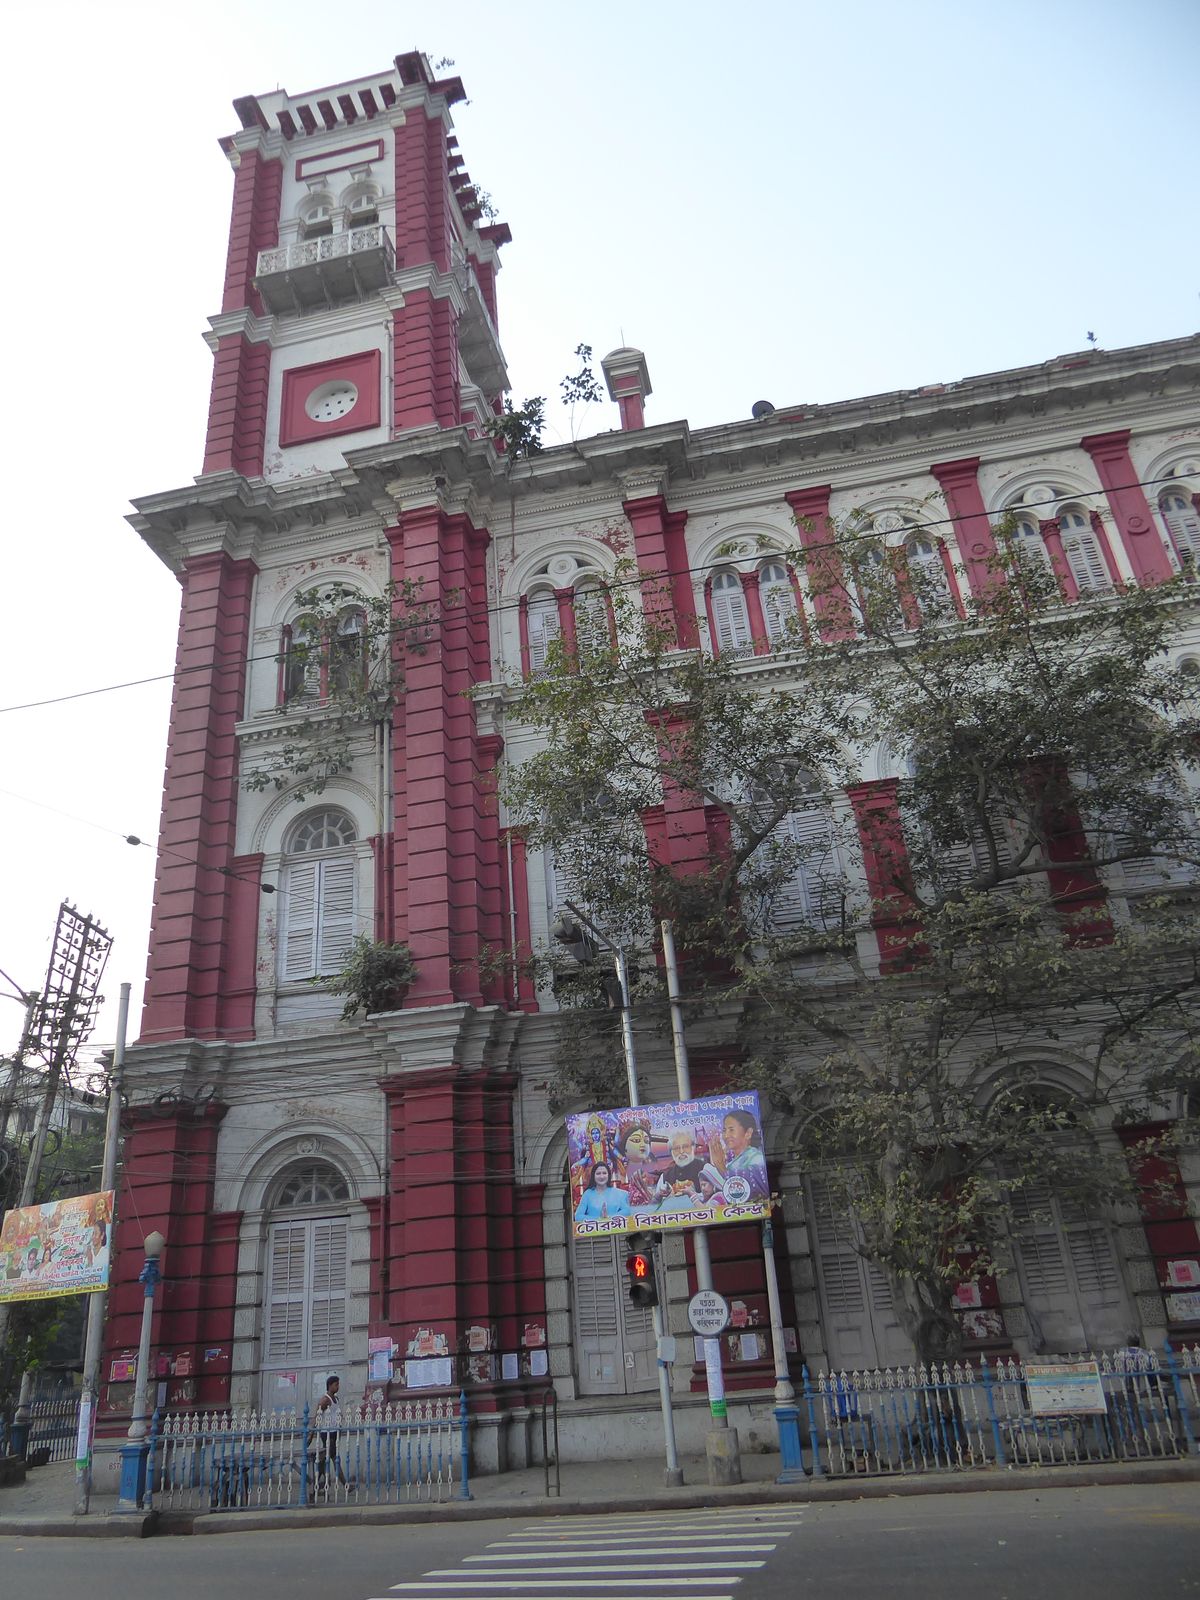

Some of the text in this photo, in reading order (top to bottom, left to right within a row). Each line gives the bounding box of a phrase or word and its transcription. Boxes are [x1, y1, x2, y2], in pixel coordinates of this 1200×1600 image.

[576, 1202, 766, 1235] চৌরঙ্গী বিধানসভা কেন্দ্র
